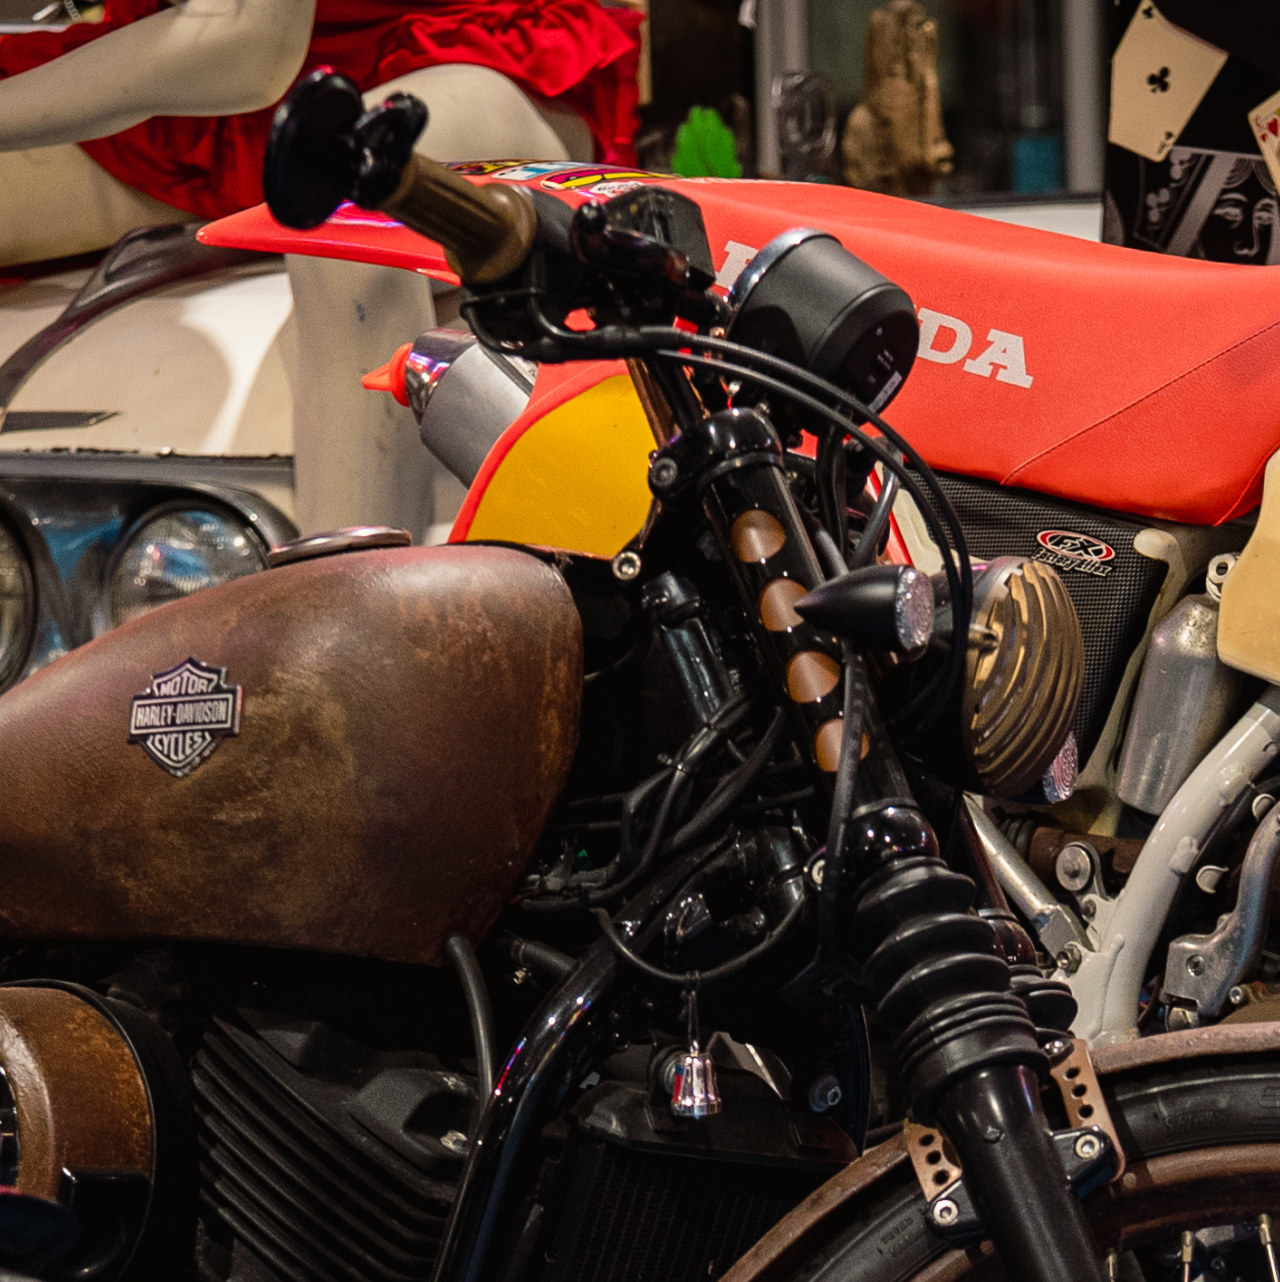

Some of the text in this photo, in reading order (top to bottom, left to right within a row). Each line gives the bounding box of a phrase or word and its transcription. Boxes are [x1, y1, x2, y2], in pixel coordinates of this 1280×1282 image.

[159, 670, 209, 696] MOTOR
[135, 700, 228, 727] HARLEY-DAVIDSON
[153, 731, 204, 762] CYCLES
